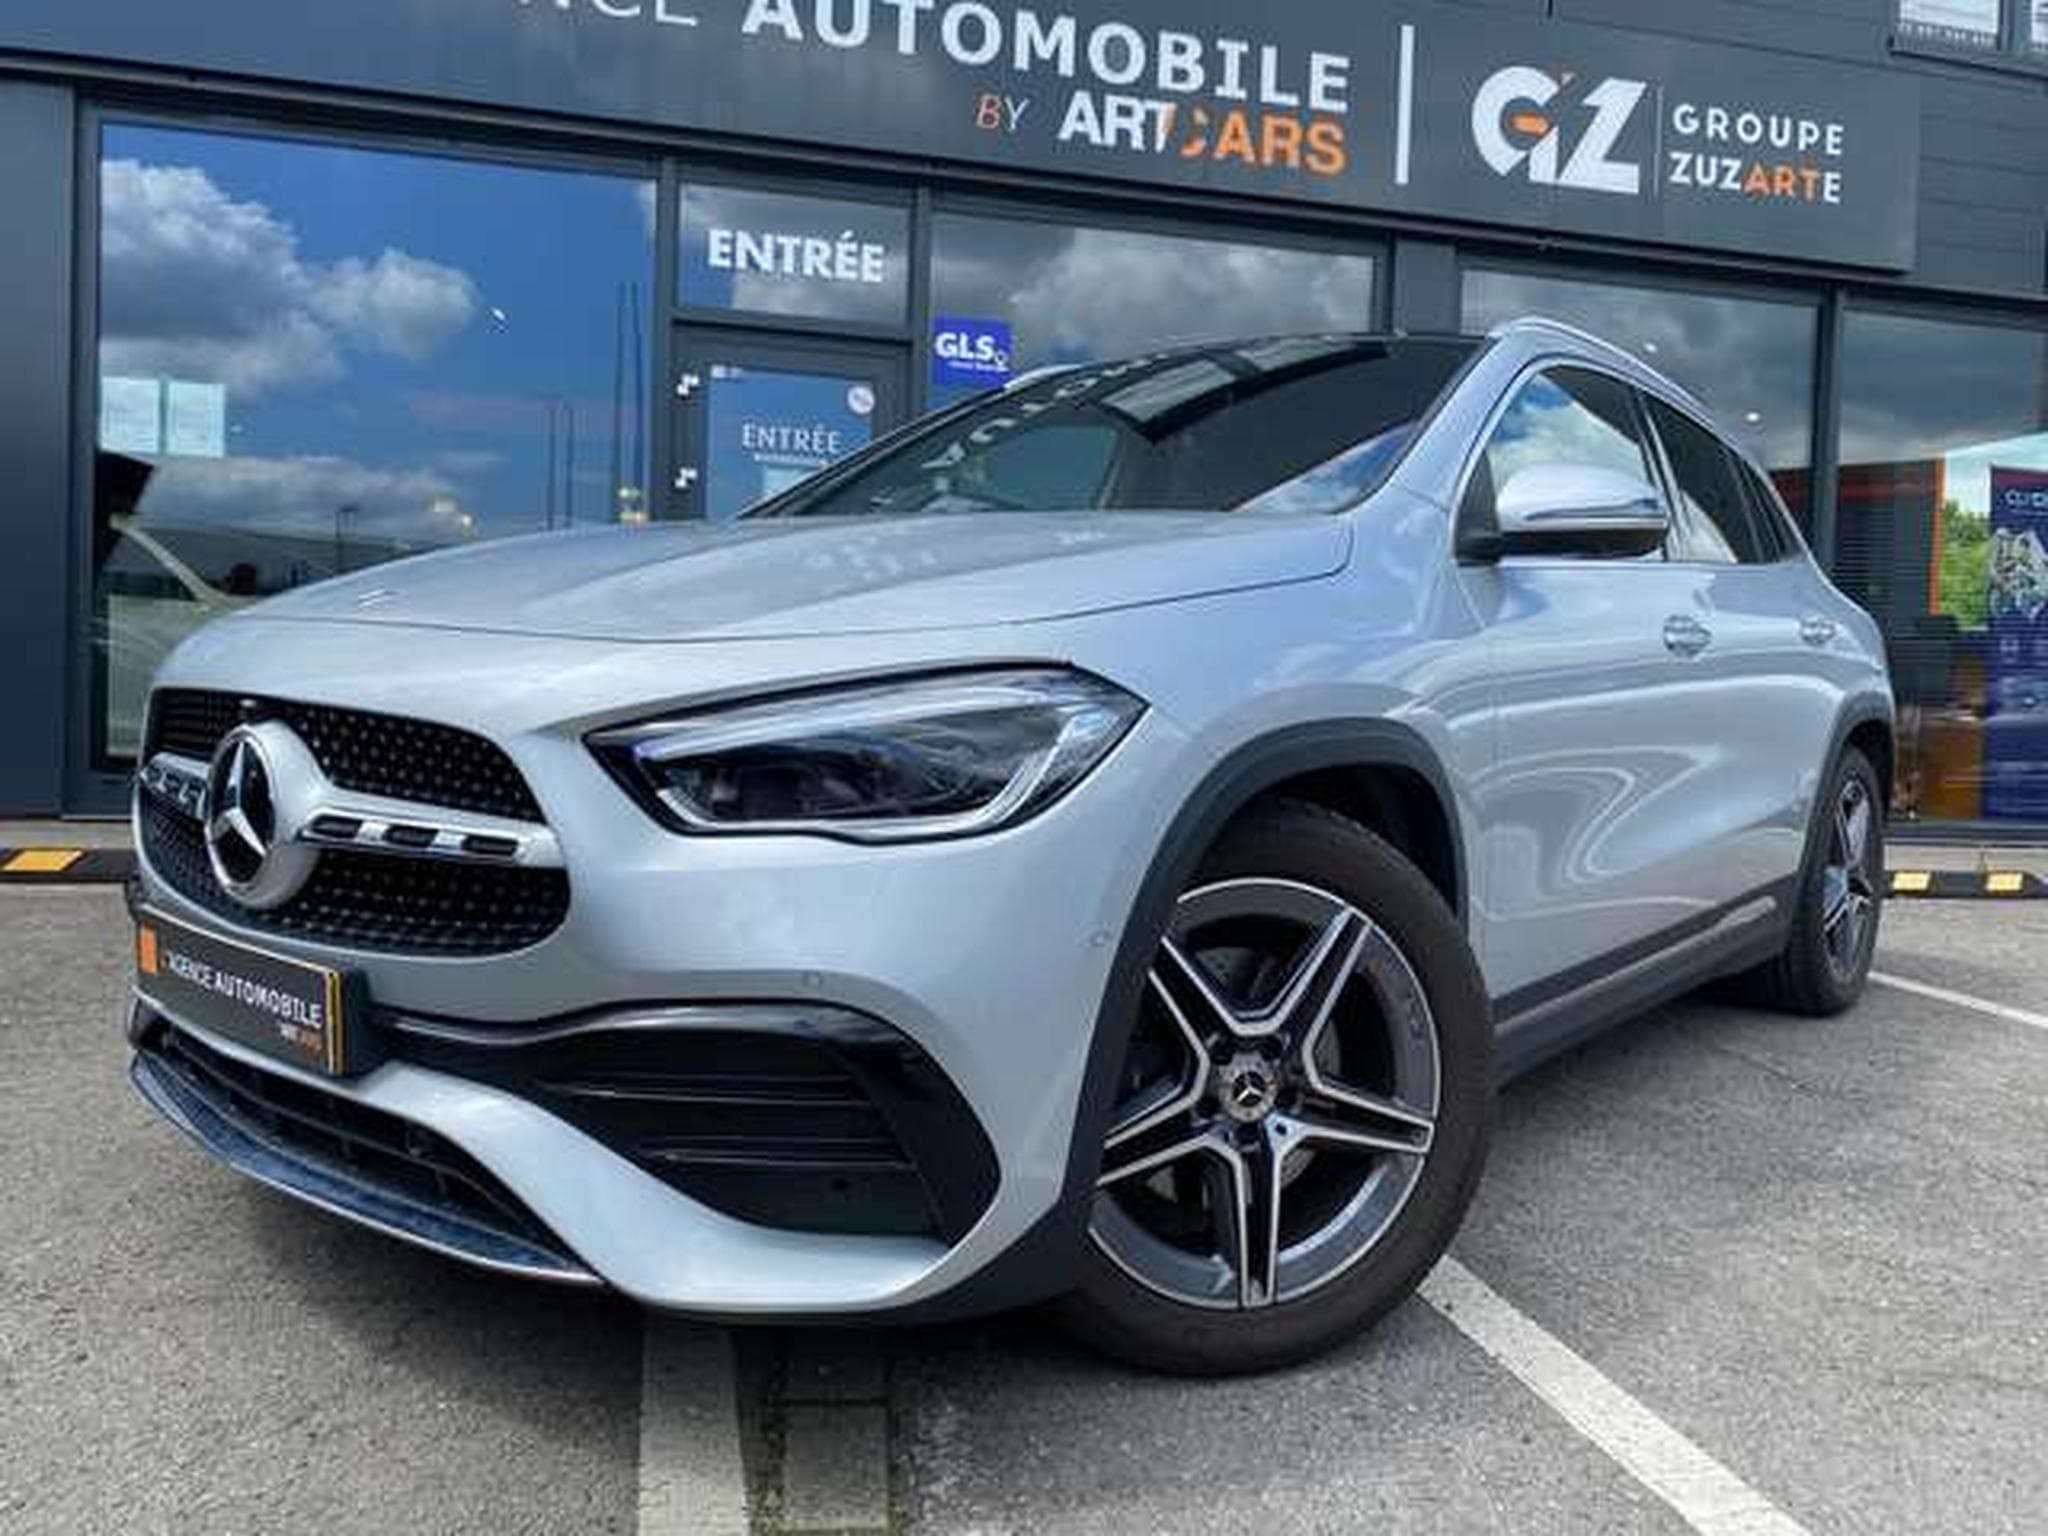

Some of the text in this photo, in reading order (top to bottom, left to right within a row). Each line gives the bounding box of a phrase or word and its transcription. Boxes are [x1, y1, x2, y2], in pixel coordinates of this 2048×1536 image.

[742, 0, 1351, 113] AUTOMOBILE
[976, 94, 1030, 131] BY
[1672, 103, 1844, 156] GROUPE
[1669, 151, 1842, 204] ZUZARTE
[707, 228, 885, 284] ENTRÉE
[936, 331, 996, 361] GLS
[741, 421, 842, 455] ENTRÉE
[214, 970, 322, 1030] AUTOMOBILE
